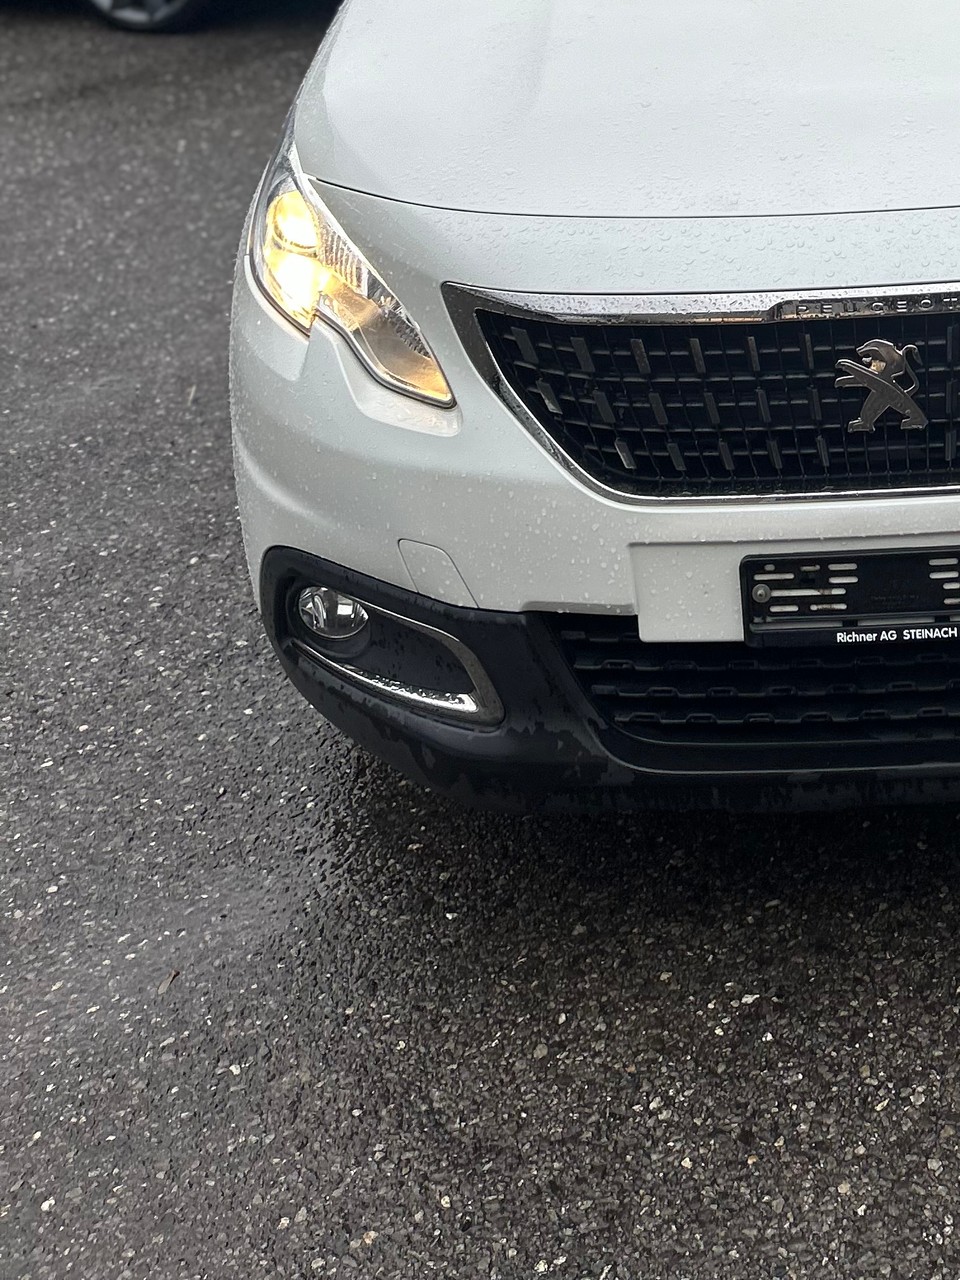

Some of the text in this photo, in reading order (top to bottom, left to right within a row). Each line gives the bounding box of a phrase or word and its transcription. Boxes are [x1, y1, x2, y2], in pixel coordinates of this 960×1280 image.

[796, 298, 958, 315] PEUGEOT
[836, 627, 957, 642] Richner AG STEINACH
